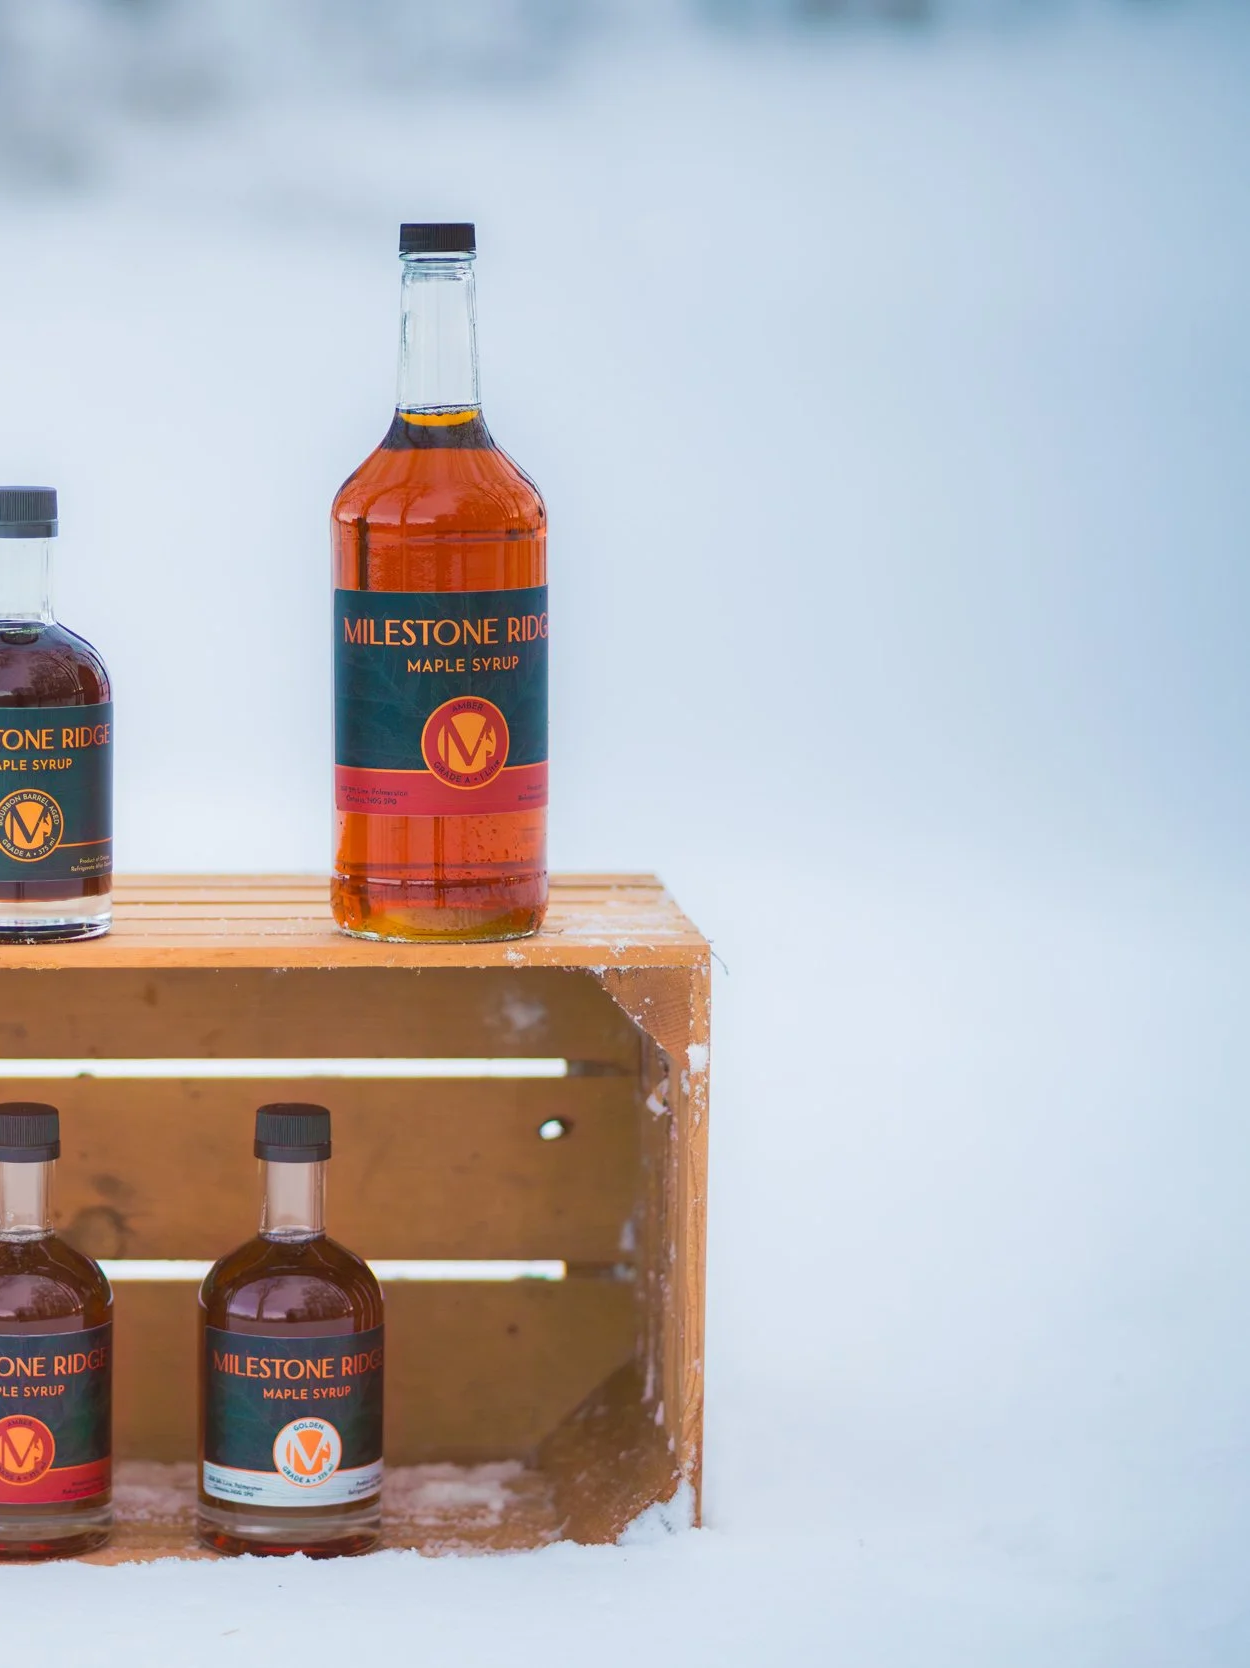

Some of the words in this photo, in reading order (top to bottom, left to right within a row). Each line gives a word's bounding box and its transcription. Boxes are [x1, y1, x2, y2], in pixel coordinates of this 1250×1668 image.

[344, 617, 499, 646] MILESTONE
[407, 658, 466, 673] MAPLE
[472, 655, 519, 672] SYRUP
[452, 701, 484, 712] AMBER
[62, 724, 110, 749] RIDGE
[32, 758, 73, 771] SYRUP
[434, 761, 462, 782] GRADE
[23, 793, 49, 806] BARREL
[48, 805, 60, 825] AGED
[2, 839, 24, 857] GRADE
[38, 846, 49, 855] 375
[54, 1346, 109, 1376] RIDGE
[213, 1350, 335, 1380] MILESTONE
[24, 1384, 65, 1398] SYRUP
[263, 1388, 308, 1400] MAPLE
[313, 1385, 351, 1399] SYRUP
[293, 1421, 324, 1431] GOLDEN
[282, 1465, 303, 1483] GRADE
